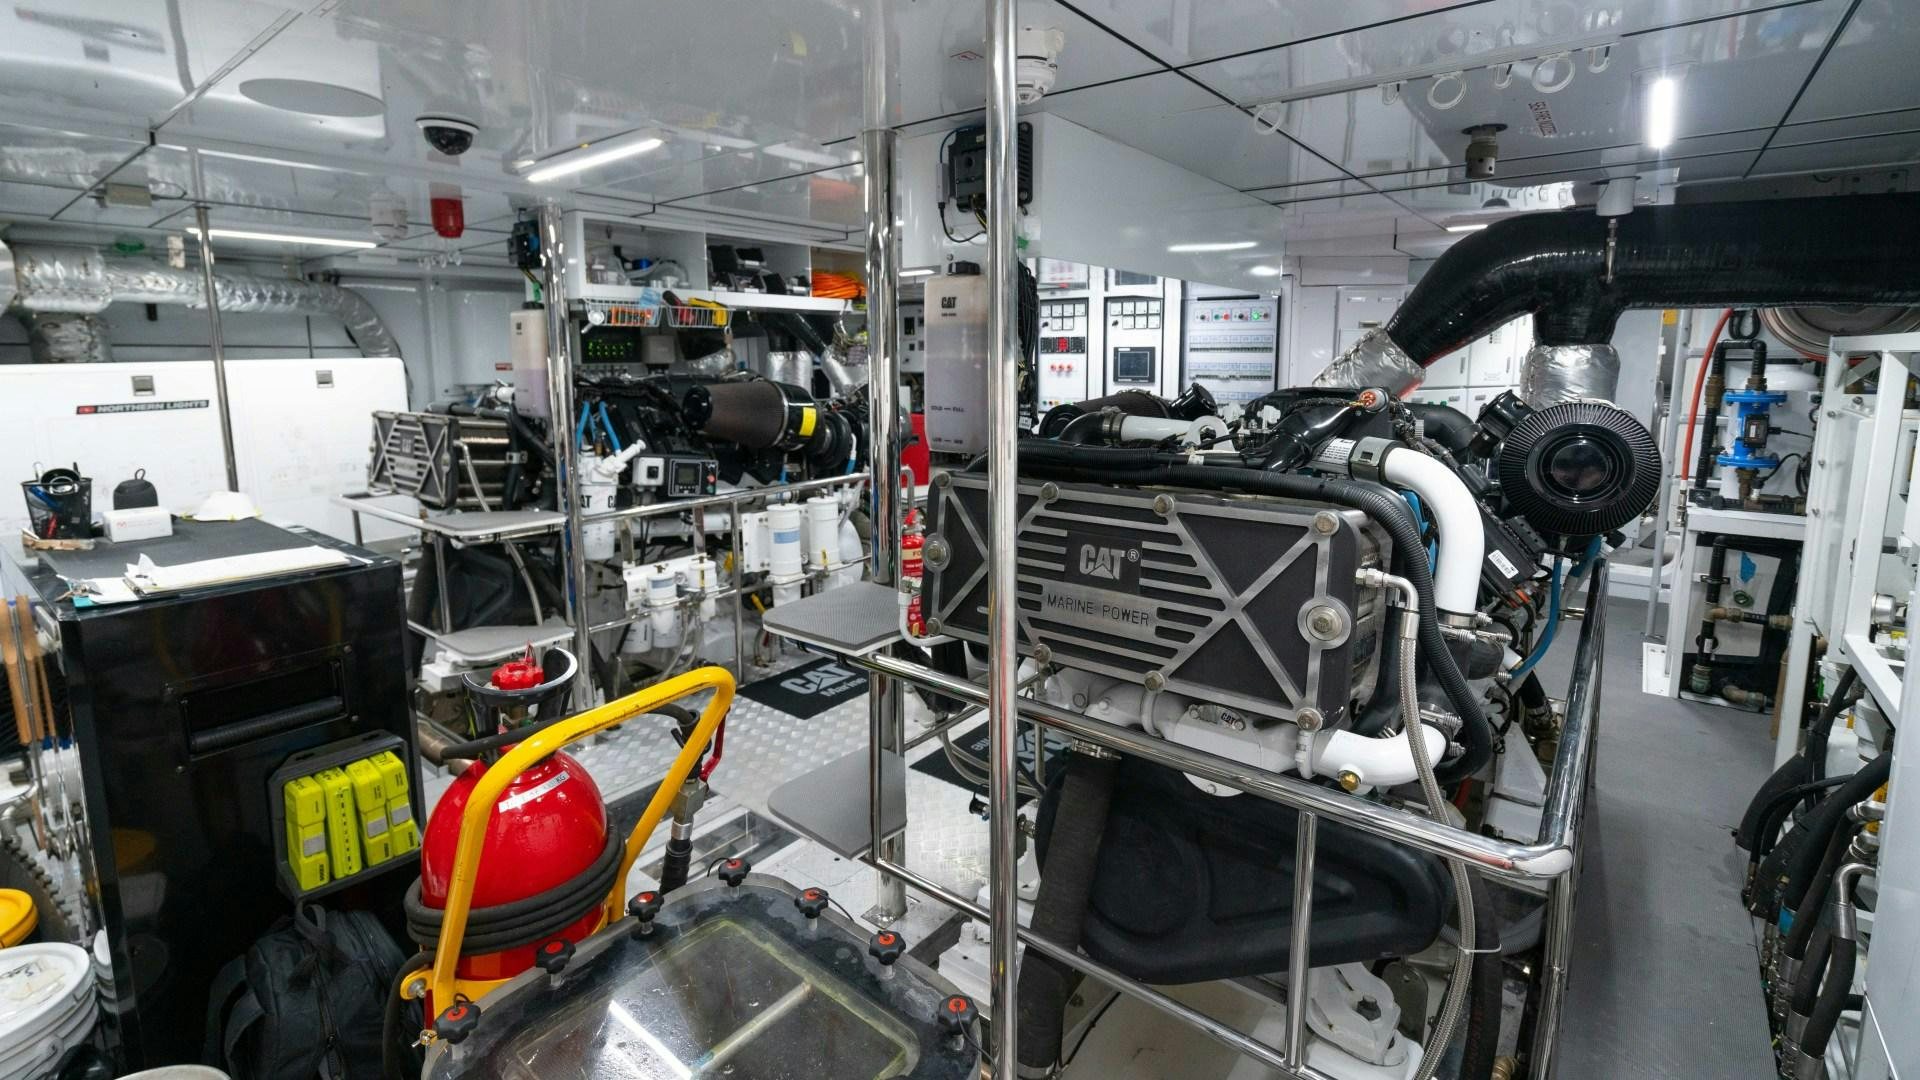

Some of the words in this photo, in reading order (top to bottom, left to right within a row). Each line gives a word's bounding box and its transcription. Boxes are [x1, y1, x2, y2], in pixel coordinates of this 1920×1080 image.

[941, 296, 957, 309] CAT
[97, 402, 165, 413] NORTHERN
[166, 400, 208, 410] LIGHTS
[1047, 594, 1094, 615] MARINE
[1102, 604, 1149, 626] POWER
[780, 662, 857, 695] CAT
[820, 677, 867, 697] Marine
